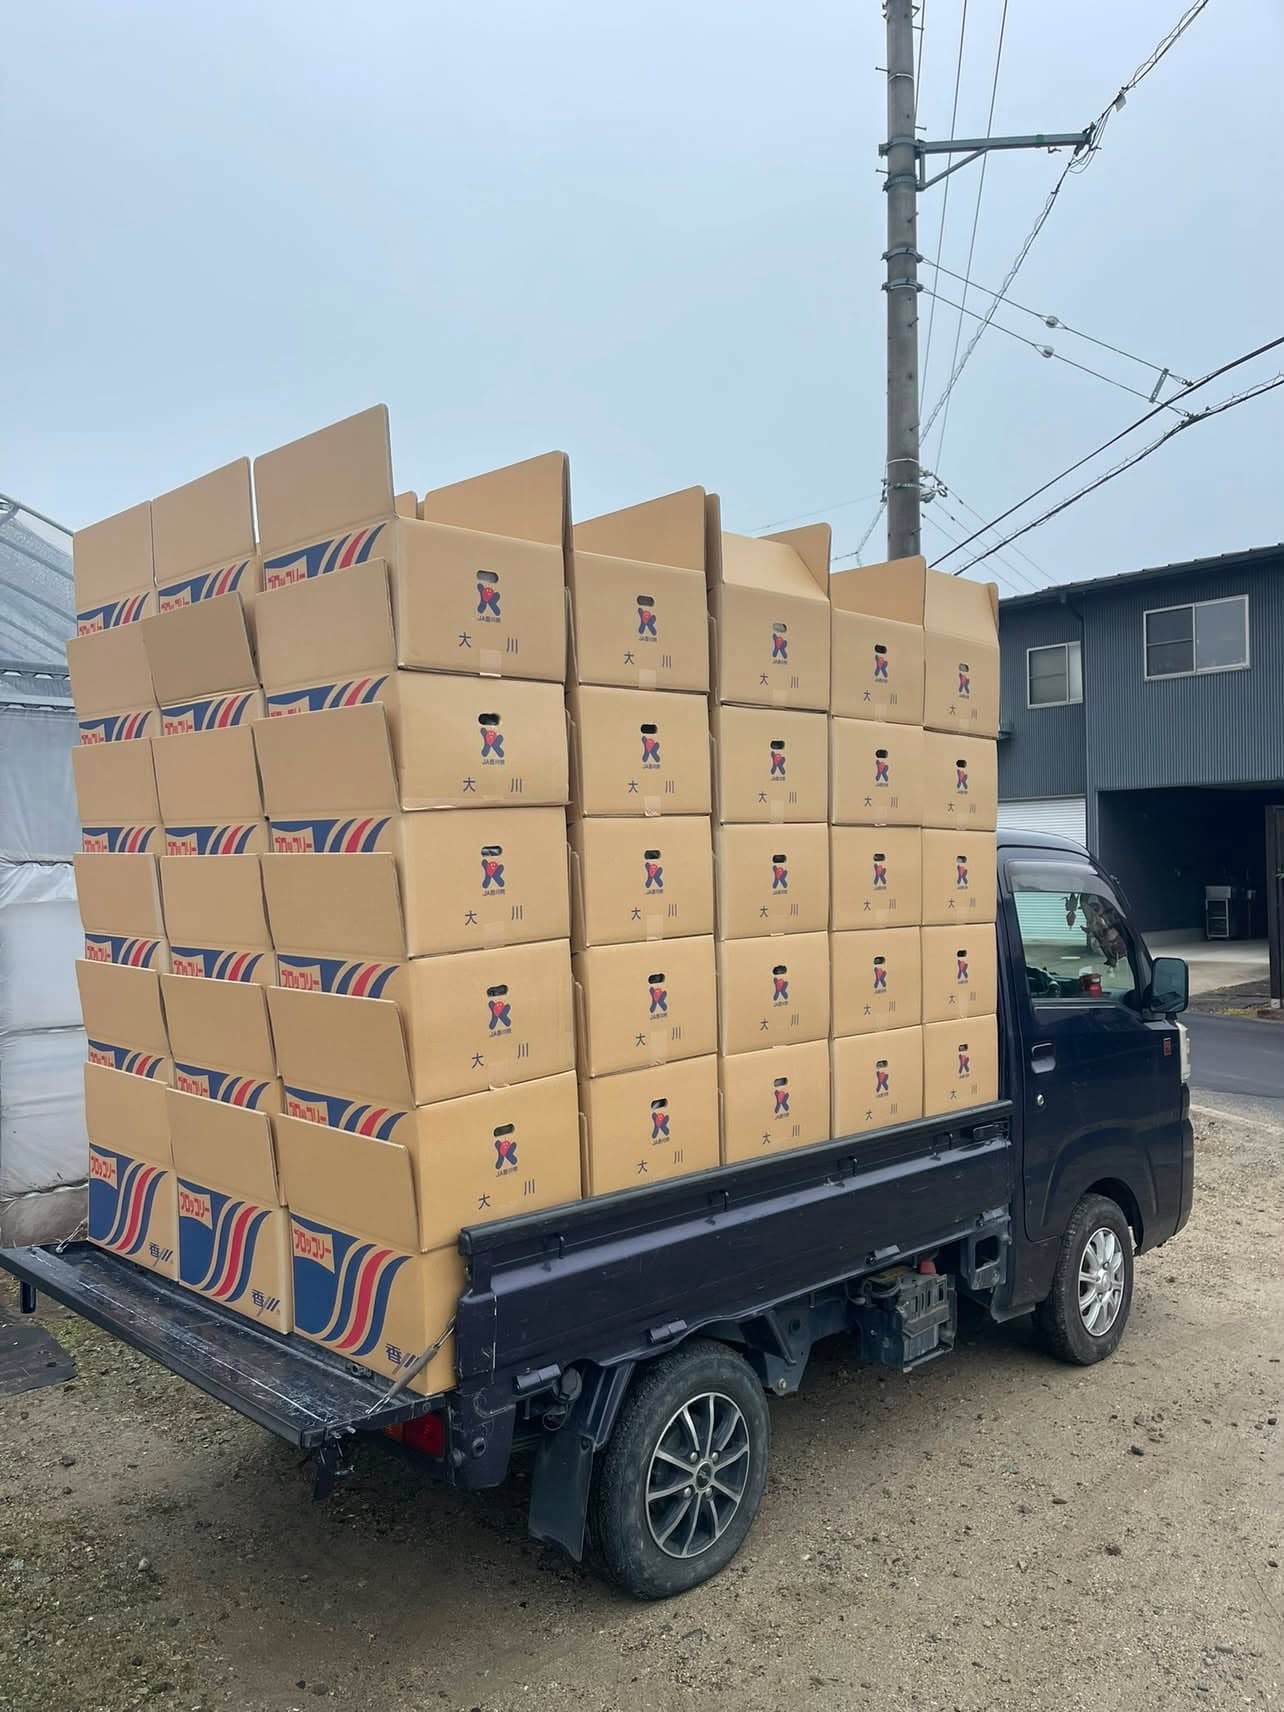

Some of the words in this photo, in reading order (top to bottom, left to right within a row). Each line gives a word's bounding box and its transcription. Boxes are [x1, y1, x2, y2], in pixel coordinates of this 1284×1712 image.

[459, 632, 518, 654] 大川
[624, 651, 671, 669] 大川
[463, 777, 522, 792] 大川
[627, 780, 674, 793] 大川
[465, 905, 522, 925] 大川
[631, 904, 677, 920] 大川
[635, 1026, 681, 1047] 大川
[472, 1043, 528, 1069] 大川
[91, 1155, 116, 1178] ブロッコリー
[637, 1149, 684, 1174] 大川
[180, 1191, 210, 1217] ブロッコリー
[478, 1178, 536, 1210] 大川
[149, 1242, 173, 1267] 香川
[294, 1228, 331, 1260] ブロッコリー
[251, 1288, 280, 1317] 香川
[385, 1343, 419, 1375] 香川
